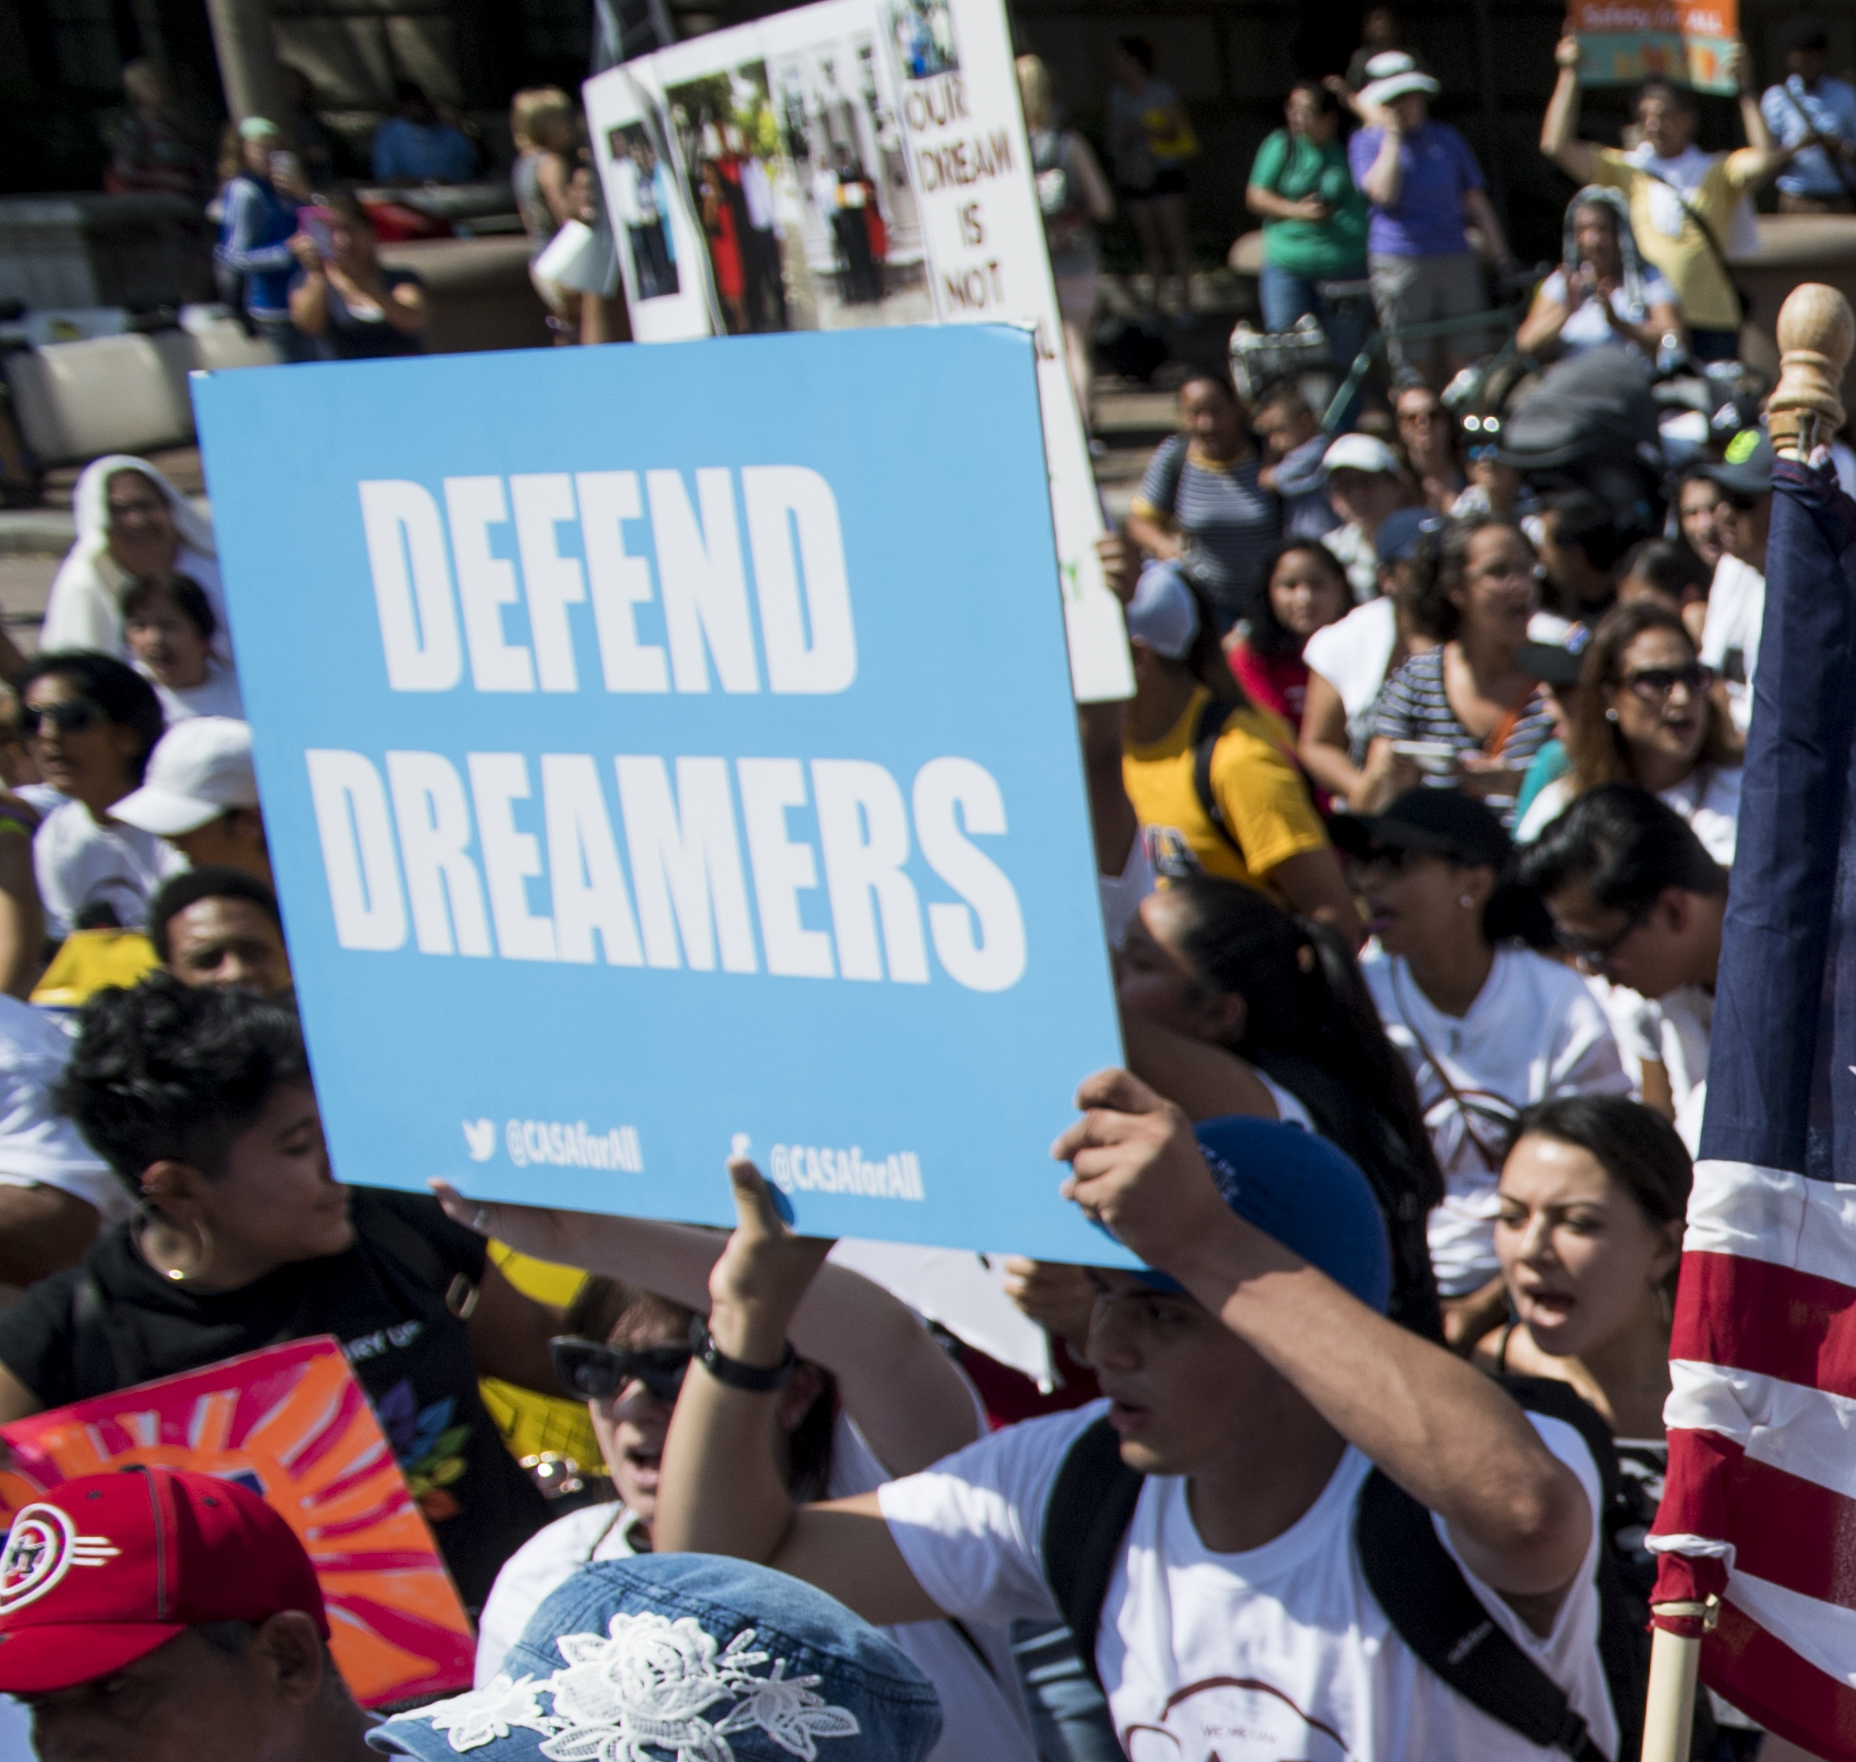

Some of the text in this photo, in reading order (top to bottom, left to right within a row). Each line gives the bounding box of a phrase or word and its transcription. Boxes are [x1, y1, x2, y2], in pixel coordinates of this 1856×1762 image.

[919, 126, 1015, 192] DREAM
[944, 260, 1004, 309] NOT
[360, 465, 857, 694] DEFEND
[306, 749, 1027, 993] DREAMERS
[505, 1118, 644, 1174] @CASAforAll
[770, 1143, 925, 1201] @CASAforAll
